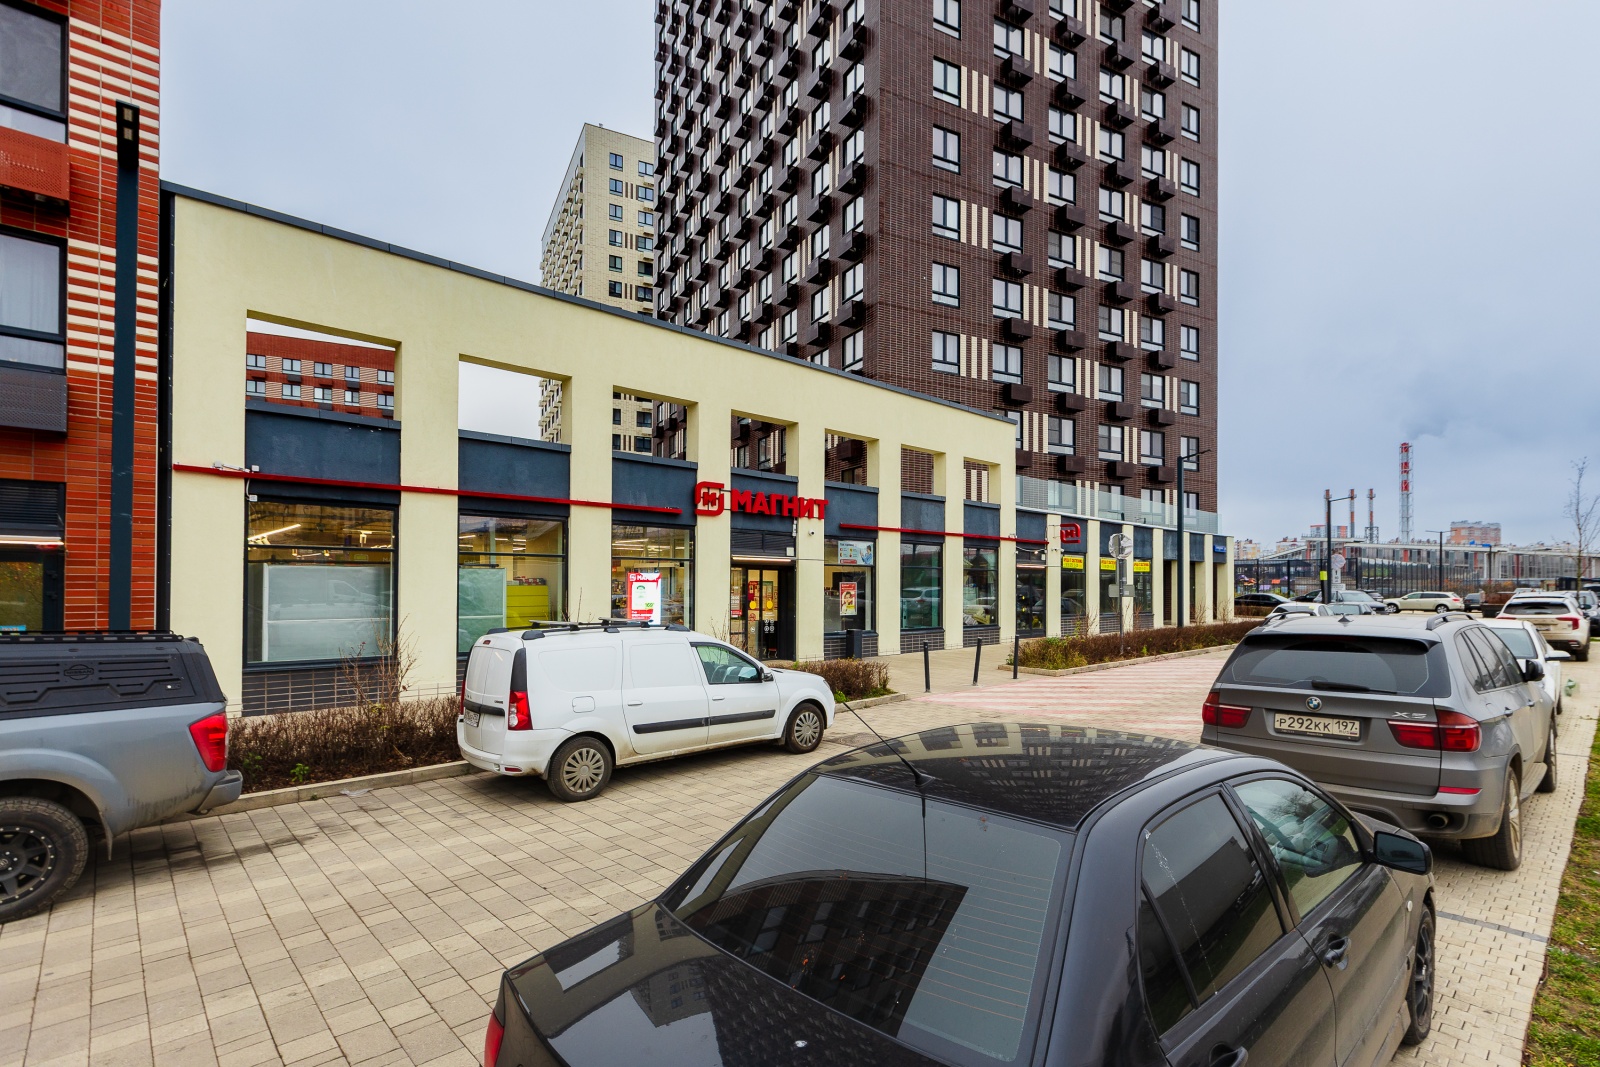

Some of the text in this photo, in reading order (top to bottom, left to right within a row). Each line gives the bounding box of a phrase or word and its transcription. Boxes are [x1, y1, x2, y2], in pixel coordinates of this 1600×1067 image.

[730, 488, 829, 520] МАГНИТ
[1391, 711, 1427, 720] X5
[1334, 720, 1356, 731] 197
